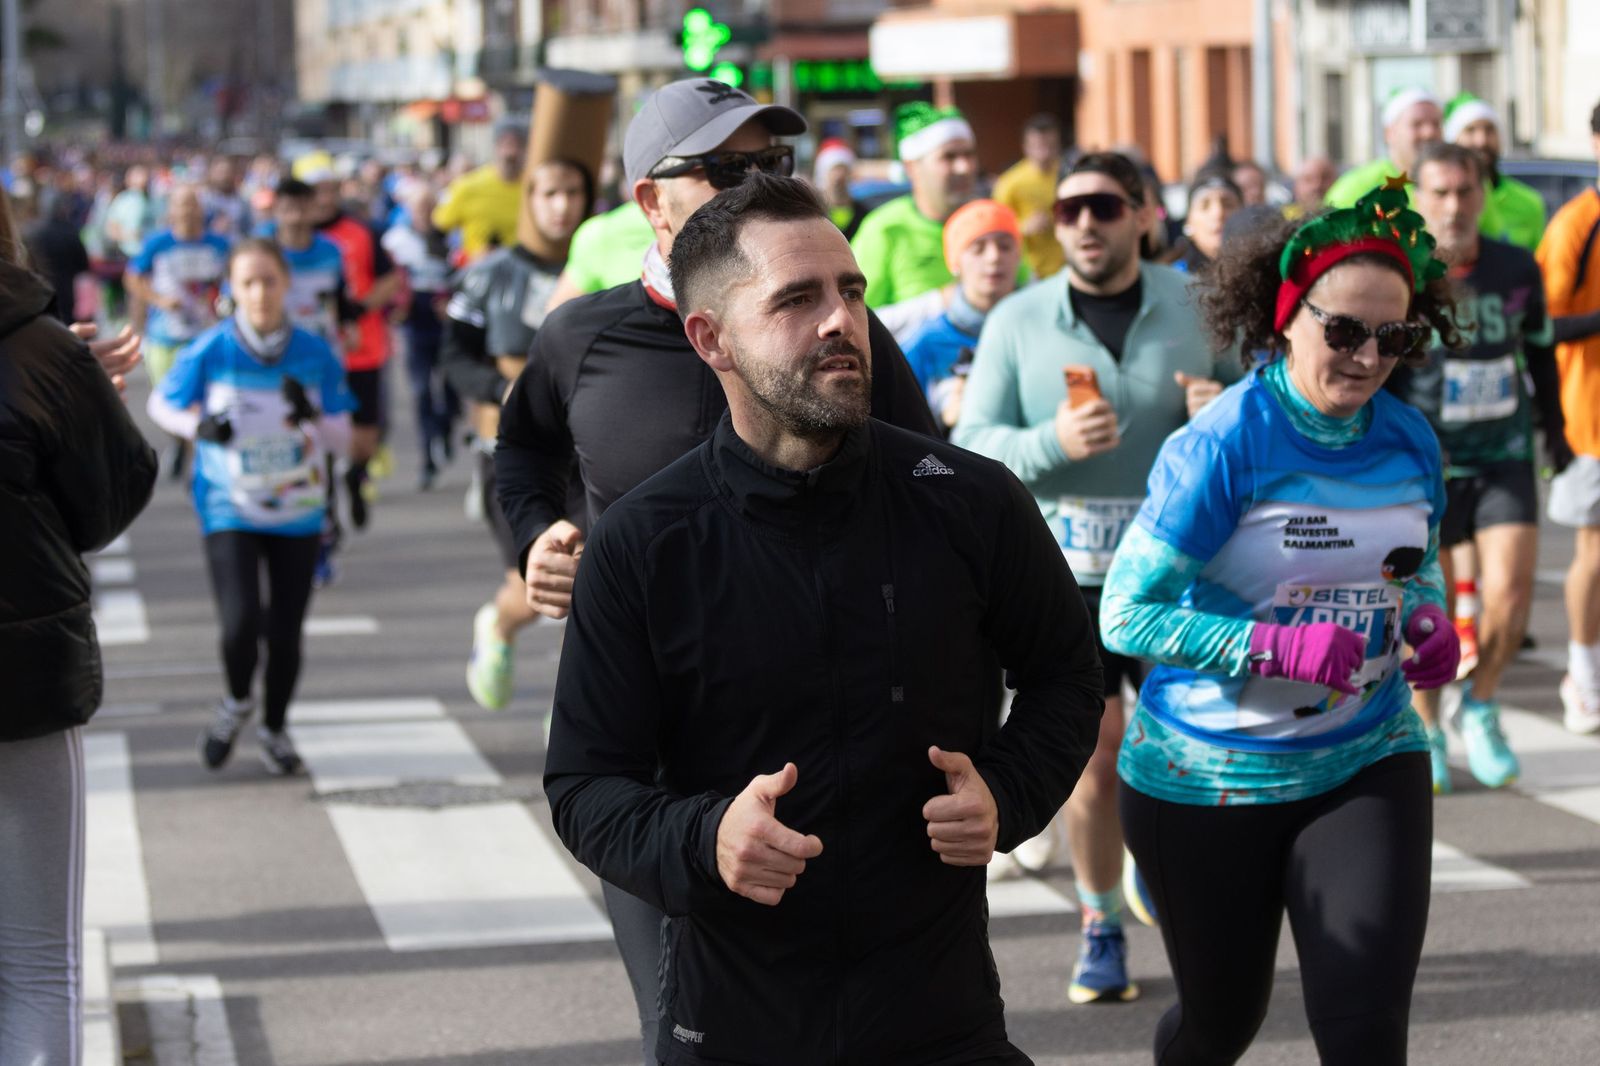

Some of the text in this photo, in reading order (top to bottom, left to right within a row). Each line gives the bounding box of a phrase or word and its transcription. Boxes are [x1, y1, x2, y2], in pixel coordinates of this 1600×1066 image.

[912, 466, 955, 476] adidas
[1306, 515, 1328, 525] SAN
[1284, 527, 1339, 537] SILVESTRE
[1283, 539, 1355, 549] SALMANTINA
[1312, 588, 1389, 605] SETEL
